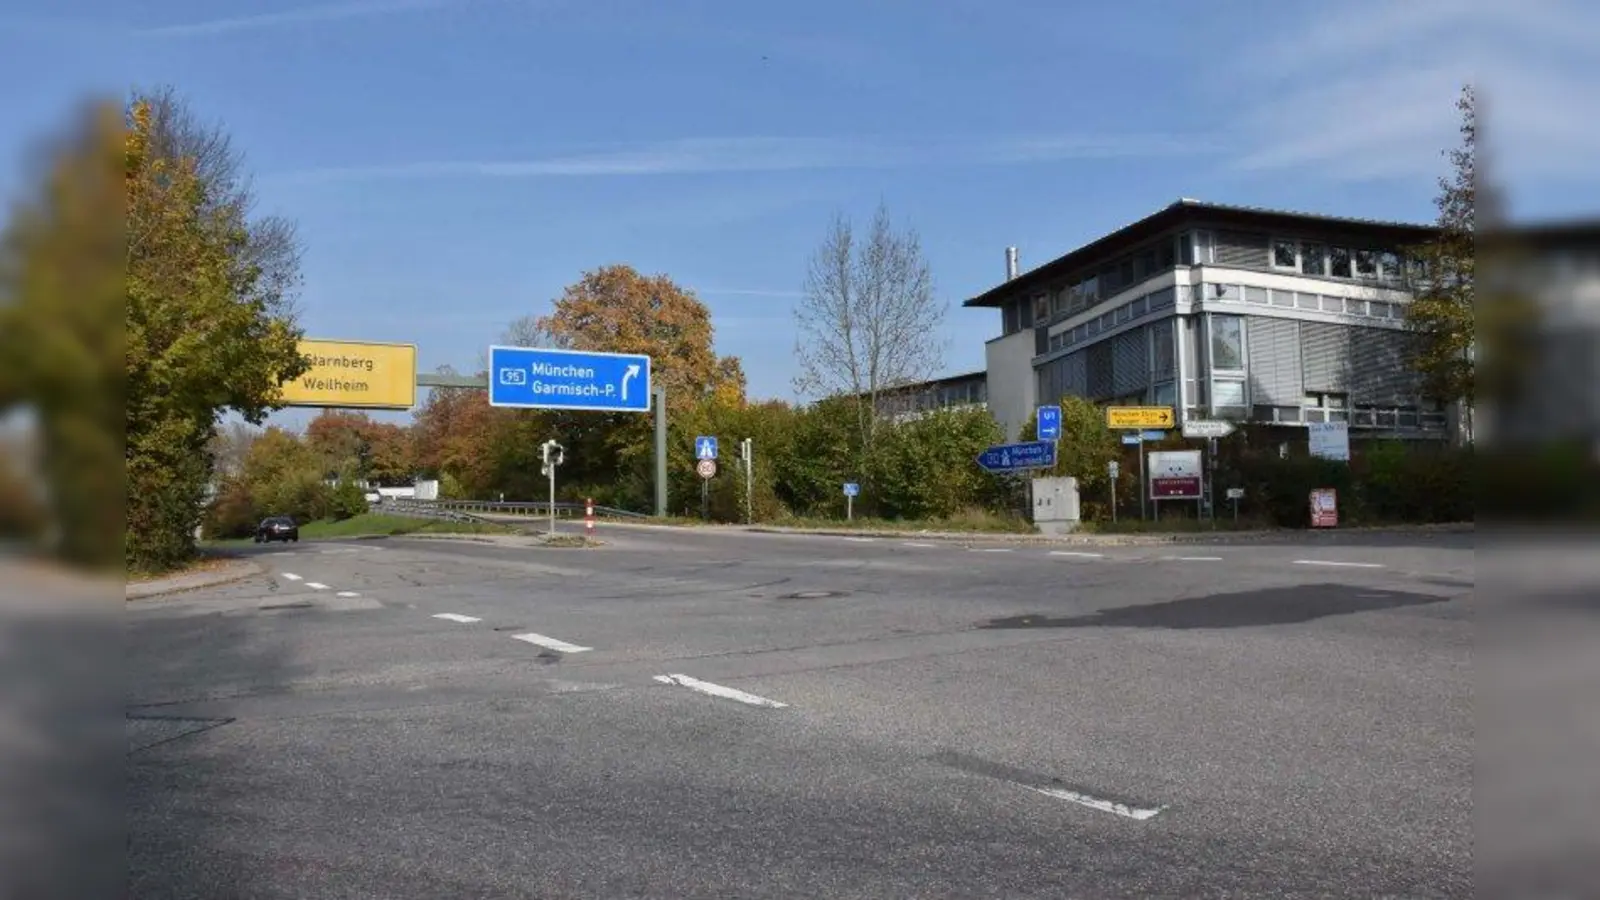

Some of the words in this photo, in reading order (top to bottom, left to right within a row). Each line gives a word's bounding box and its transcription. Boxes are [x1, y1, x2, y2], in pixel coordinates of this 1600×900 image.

[506, 371, 520, 382] 95
[532, 362, 594, 378] München
[303, 377, 369, 391] Weilheim
[531, 381, 617, 398] Garmisch-P.
